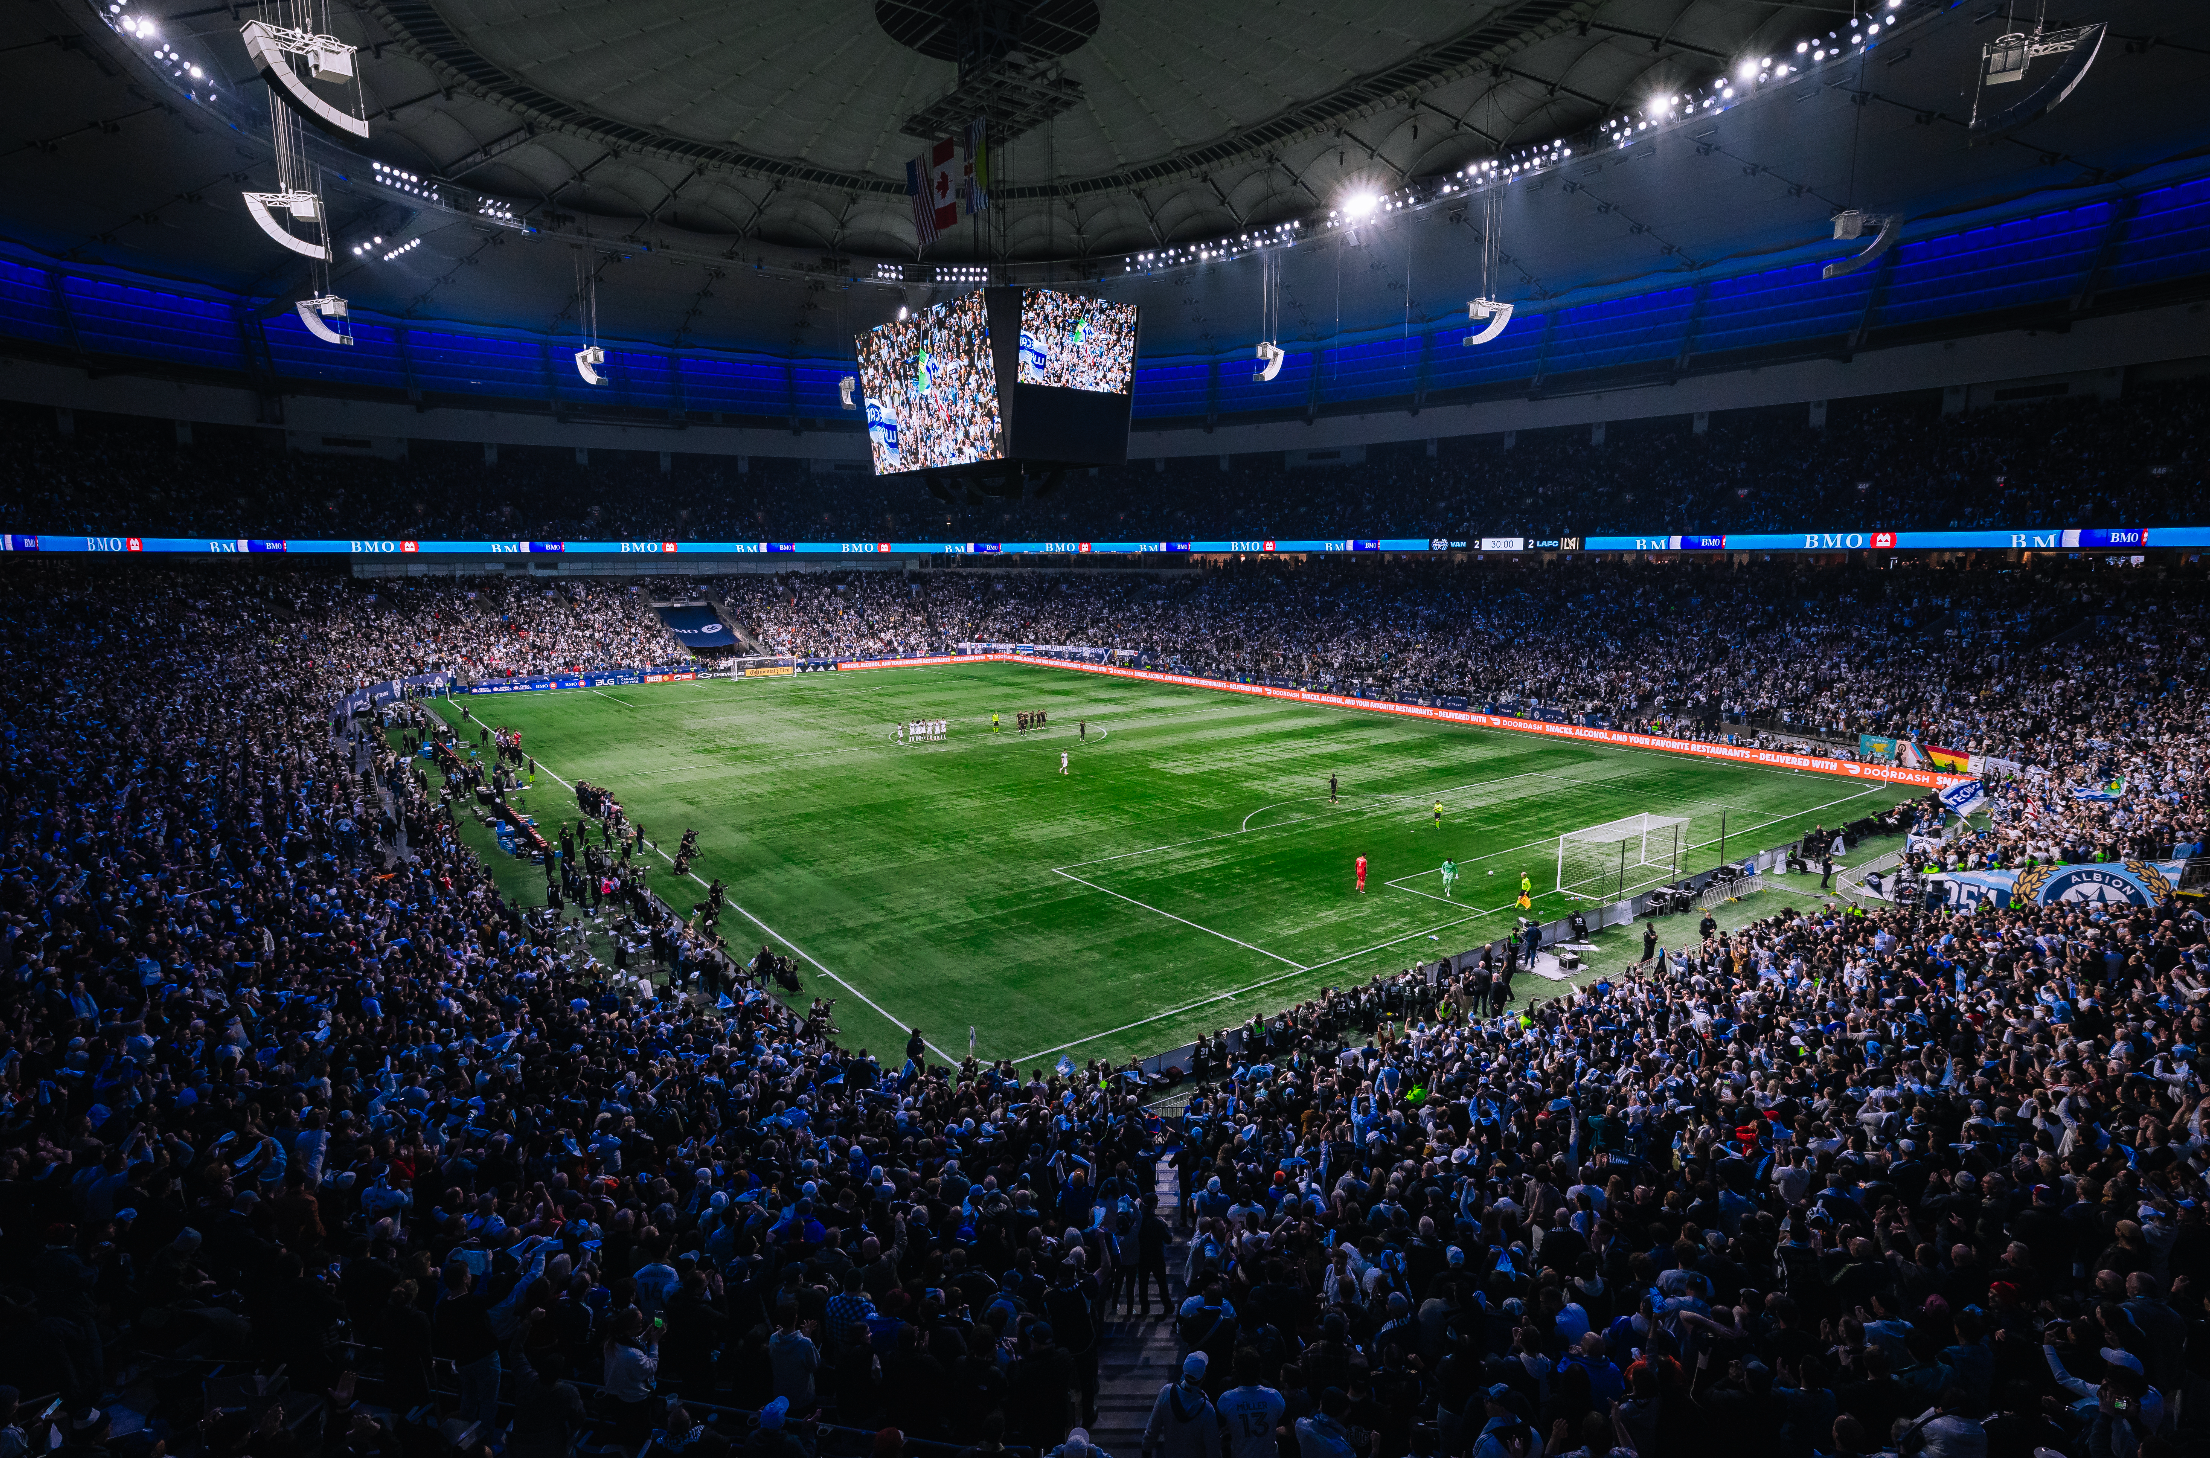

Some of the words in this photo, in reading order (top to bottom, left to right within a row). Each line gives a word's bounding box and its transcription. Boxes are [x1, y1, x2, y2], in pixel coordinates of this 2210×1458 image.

[1701, 538, 1721, 547] BMO
[1803, 534, 1863, 549] BMO
[2110, 532, 2138, 543] BMO
[87, 538, 121, 551] BMO
[351, 541, 394, 553] BMO
[621, 543, 657, 553] BMO
[842, 544, 874, 552] BMO
[1046, 543, 1075, 552] BMO
[1231, 542, 1259, 551] BMO
[1474, 540, 1480, 549] 2
[1491, 539, 1514, 549] 30:00
[1528, 539, 1534, 549] 2
[595, 678, 615, 686] BLG
[1273, 690, 1300, 698] DOORDASH
[1355, 699, 1370, 707] YOUR
[1395, 705, 1433, 716] RESTAURANTS
[1438, 710, 1470, 721] DELIVERED
[1470, 715, 1487, 723] WITH
[1502, 719, 1543, 731] DOORDASH
[1545, 724, 1574, 736] SNACKS,
[1575, 728, 1611, 741] ALCOHOL,
[1611, 734, 1628, 743] AND
[1629, 736, 1650, 745] YOUR
[1651, 739, 1690, 751] FAVORITE
[1691, 744, 1750, 759] RESTAURANTS
[1759, 753, 1810, 768] DELIVERED
[1812, 760, 1837, 771] WITH
[1863, 767, 1930, 784] DOORDASH
[2071, 870, 2136, 896] ALBION
[1275, 1020, 1285, 1030] 43
[1236, 1401, 1268, 1411] MÜLLER
[1239, 1411, 1269, 1438] 13
